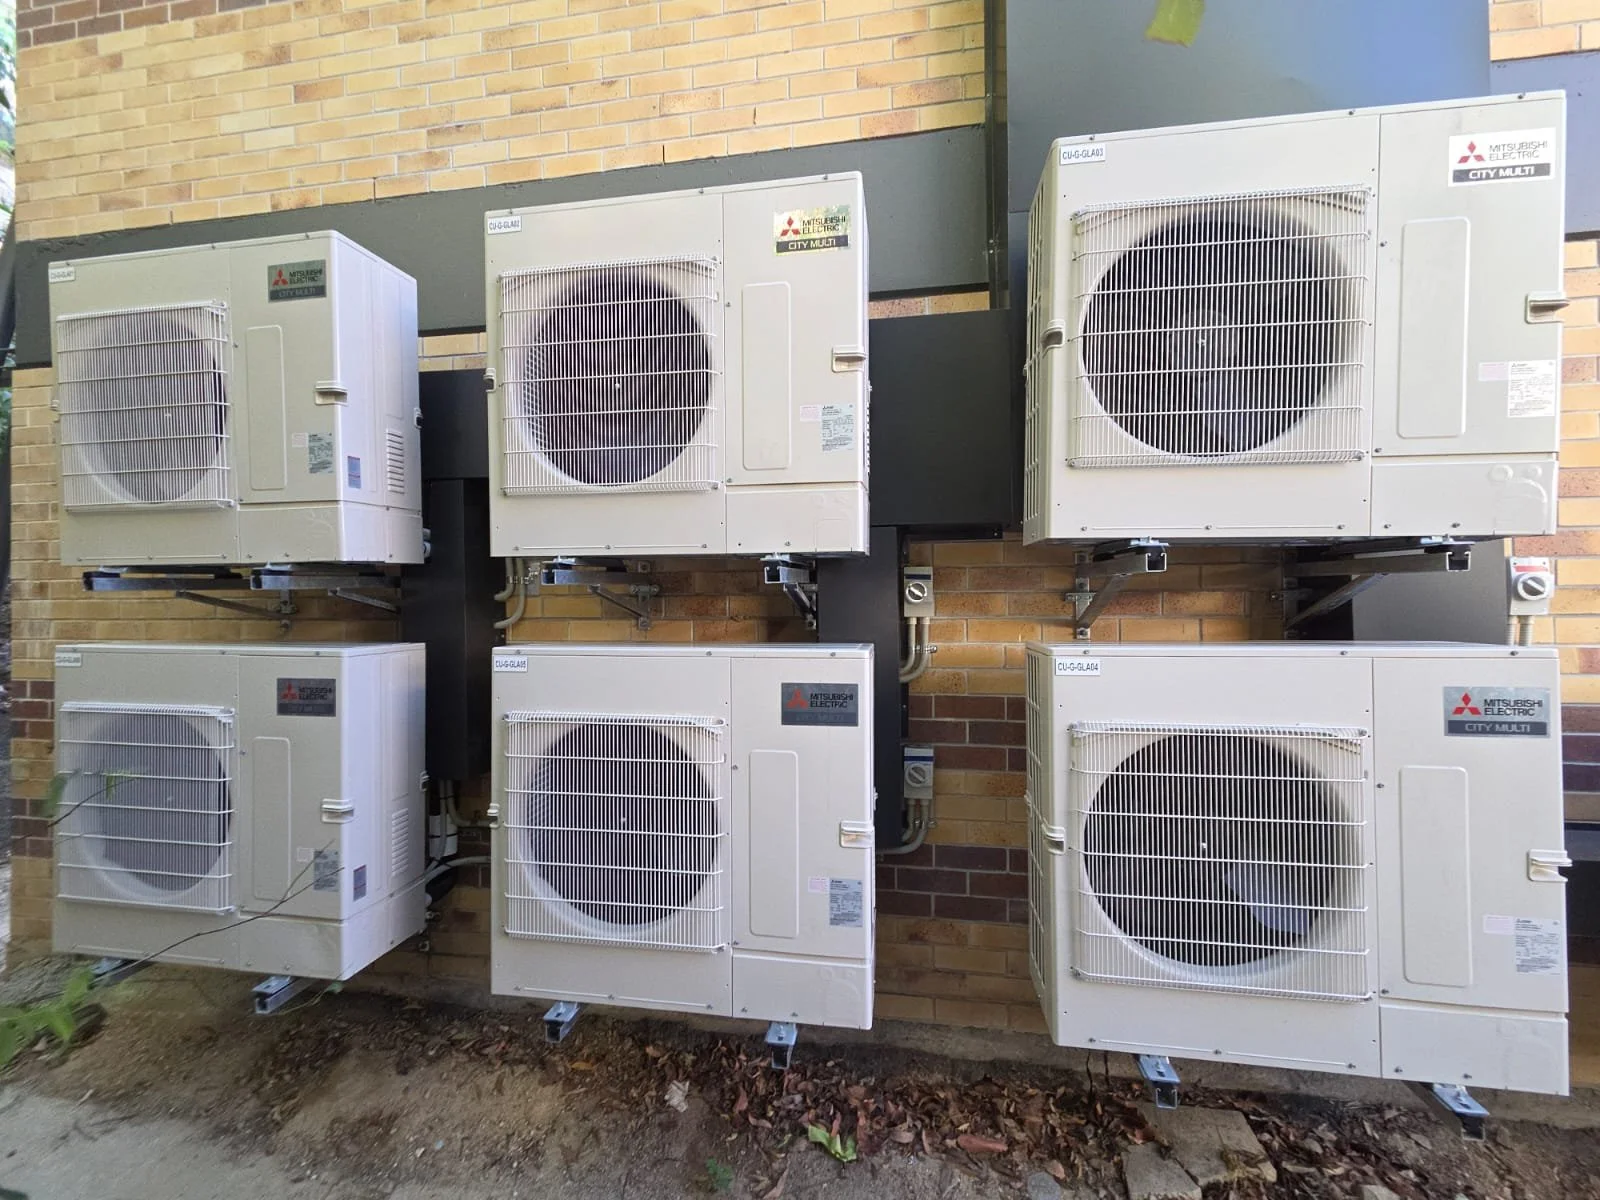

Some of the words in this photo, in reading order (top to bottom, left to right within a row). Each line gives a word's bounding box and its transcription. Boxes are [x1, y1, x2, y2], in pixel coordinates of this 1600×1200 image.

[1489, 140, 1548, 152] MITSUBISHI
[1062, 148, 1104, 160] CU-G-GLA03
[1489, 150, 1540, 161] ELECTRIC
[1468, 169, 1497, 179] CITY
[1499, 166, 1535, 177] MULTI
[802, 216, 846, 227] MITSUBISHI
[802, 224, 840, 234] ELECTRIC
[788, 241, 808, 249] CITY
[810, 238, 836, 248] MULTI
[289, 268, 322, 278] MITSUBISHI
[1057, 662, 1099, 671] CU-G-GLA04
[809, 692, 854, 701] MITSUBISHI
[809, 700, 848, 708] ELECTRIC
[1483, 699, 1544, 708] MITSUBISHI
[1483, 707, 1536, 716] ELECTRIC
[1465, 723, 1493, 732] CITY
[1495, 724, 1531, 733] MULTI
